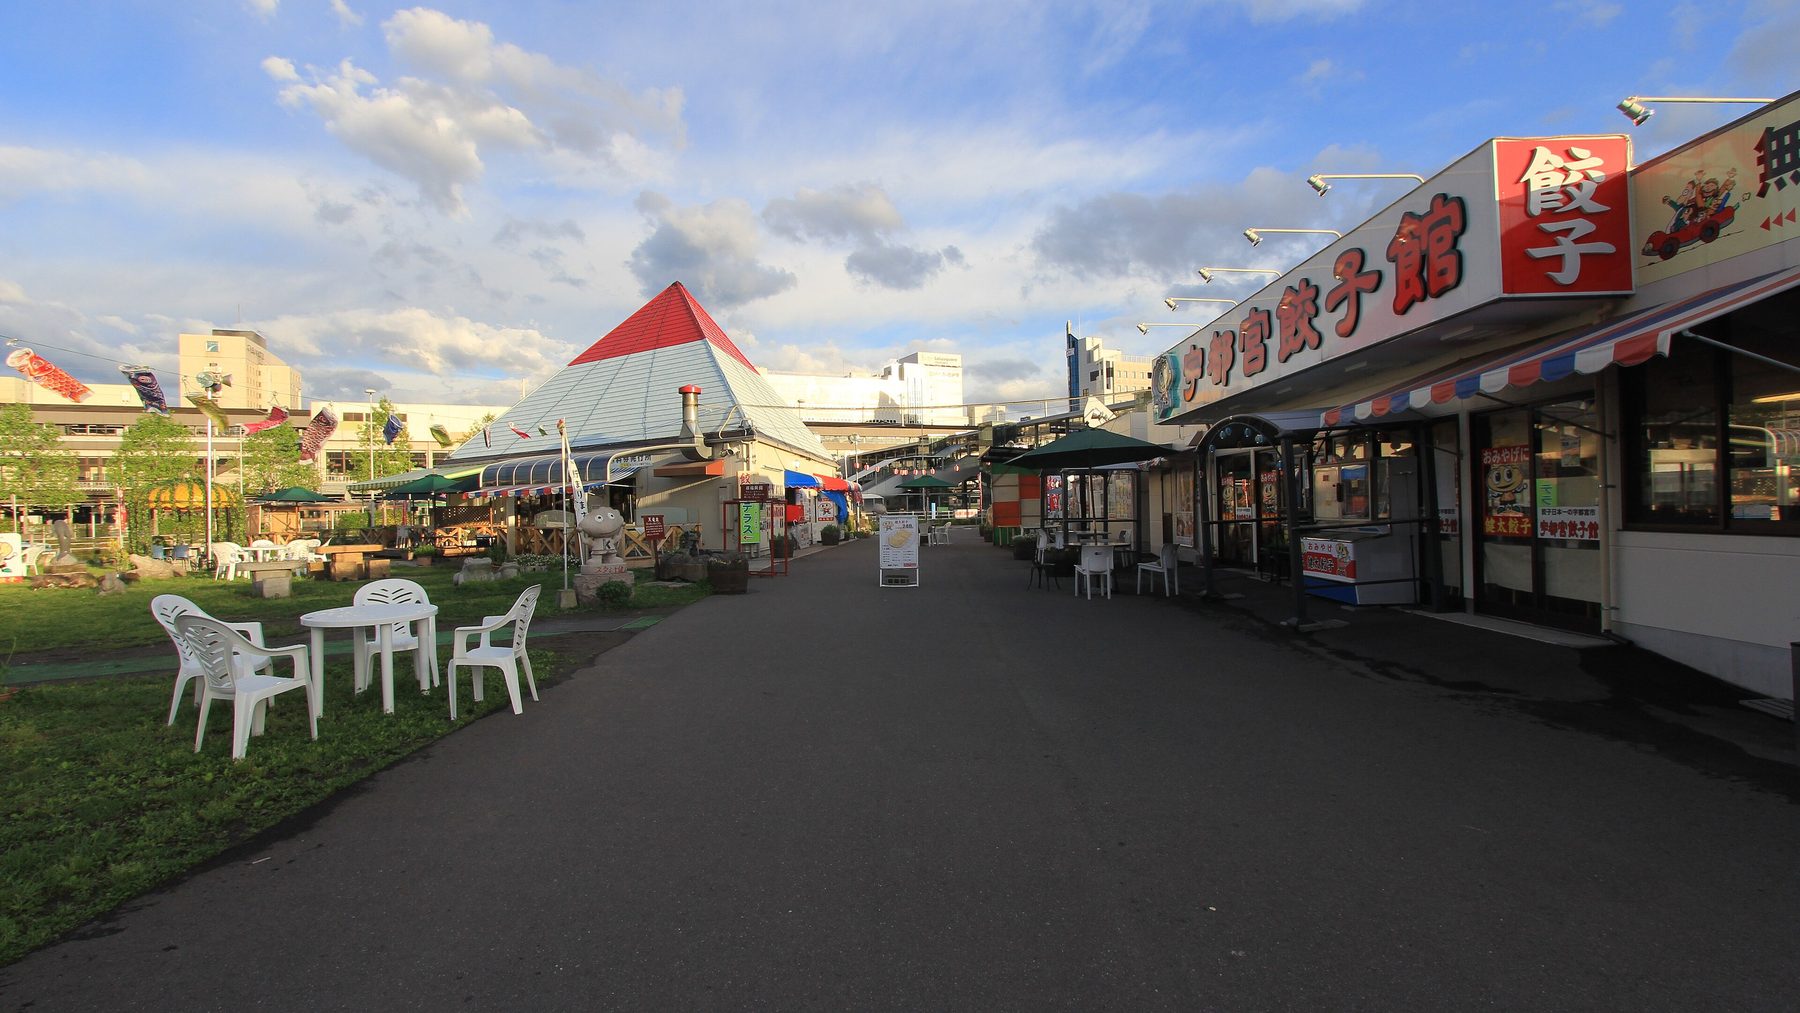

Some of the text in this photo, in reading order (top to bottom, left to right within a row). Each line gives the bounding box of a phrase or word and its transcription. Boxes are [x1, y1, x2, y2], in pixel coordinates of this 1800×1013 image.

[1519, 145, 1617, 286] 餃子
[1183, 193, 1467, 403] 宇都宮餃子館
[1482, 447, 1530, 464] おみやげに
[742, 503, 753, 534] テラス
[1485, 517, 1531, 535] 健太餃子
[1540, 519, 1599, 538] 宇都宮餃子館
